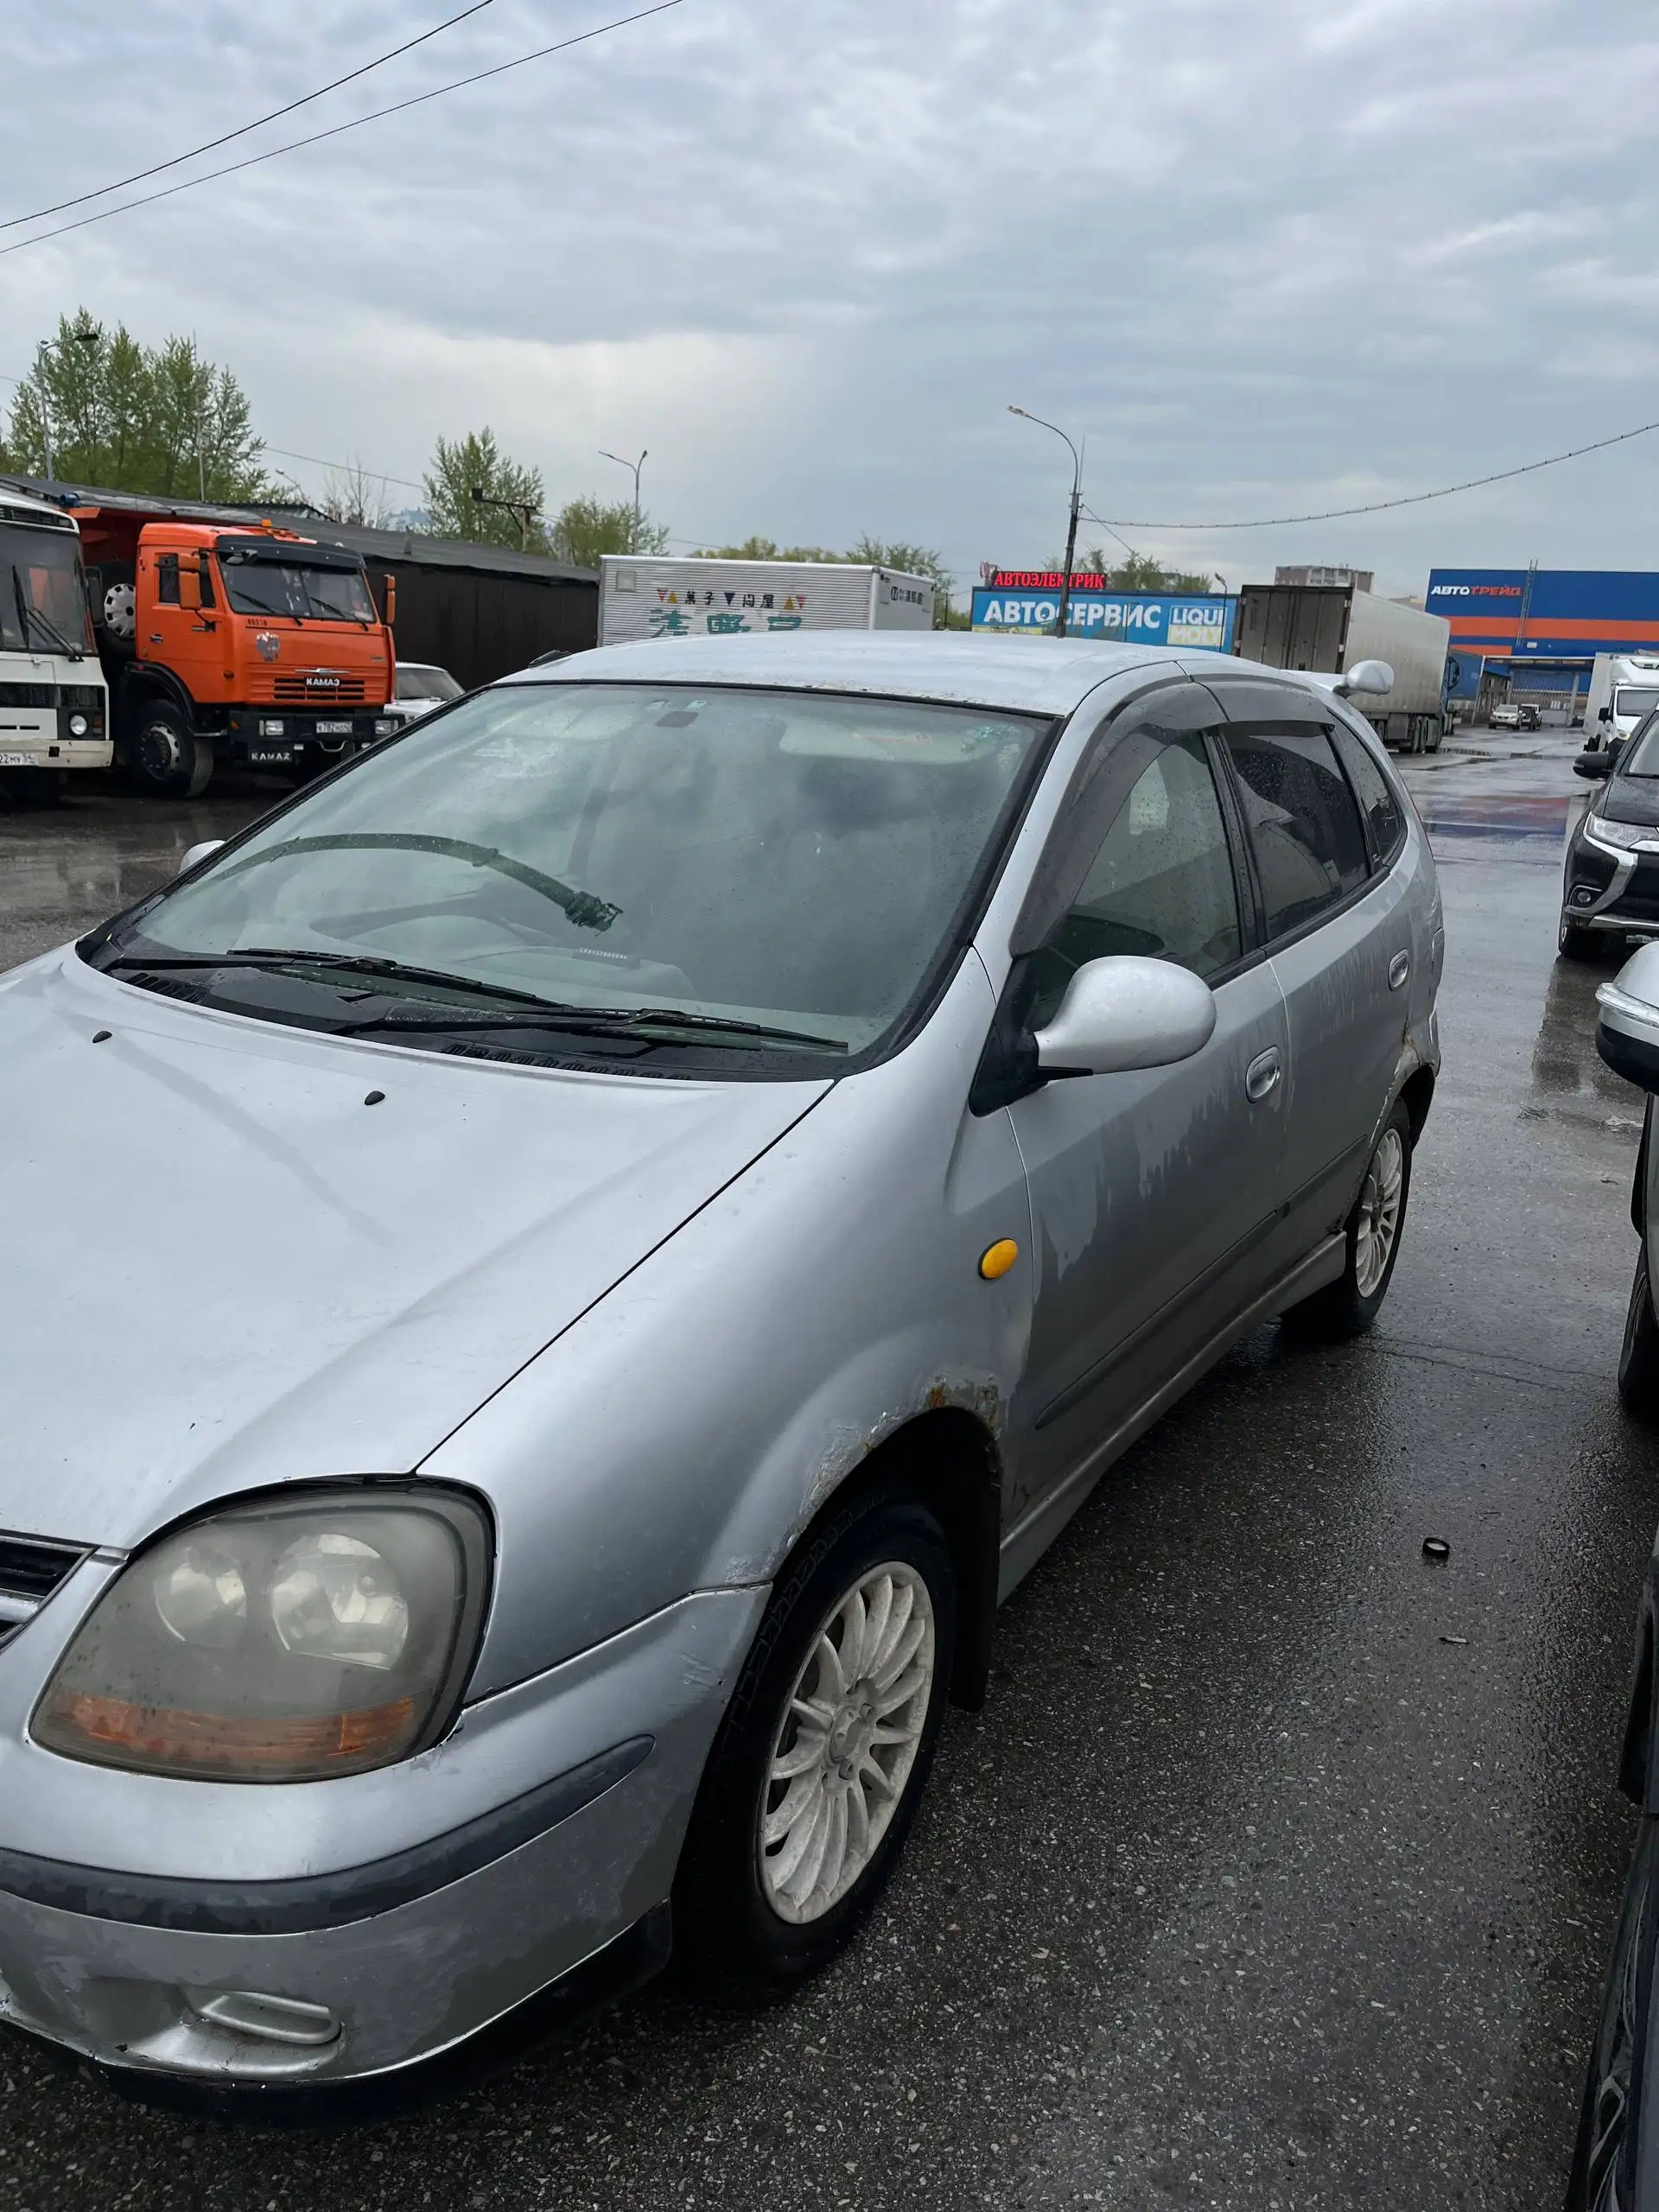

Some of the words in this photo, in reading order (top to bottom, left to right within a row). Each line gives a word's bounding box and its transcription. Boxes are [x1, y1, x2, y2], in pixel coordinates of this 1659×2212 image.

[1173, 607, 1224, 625] LIQUI
[306, 677, 340, 686] КАМАЗ
[251, 752, 291, 760] KAMAZ
